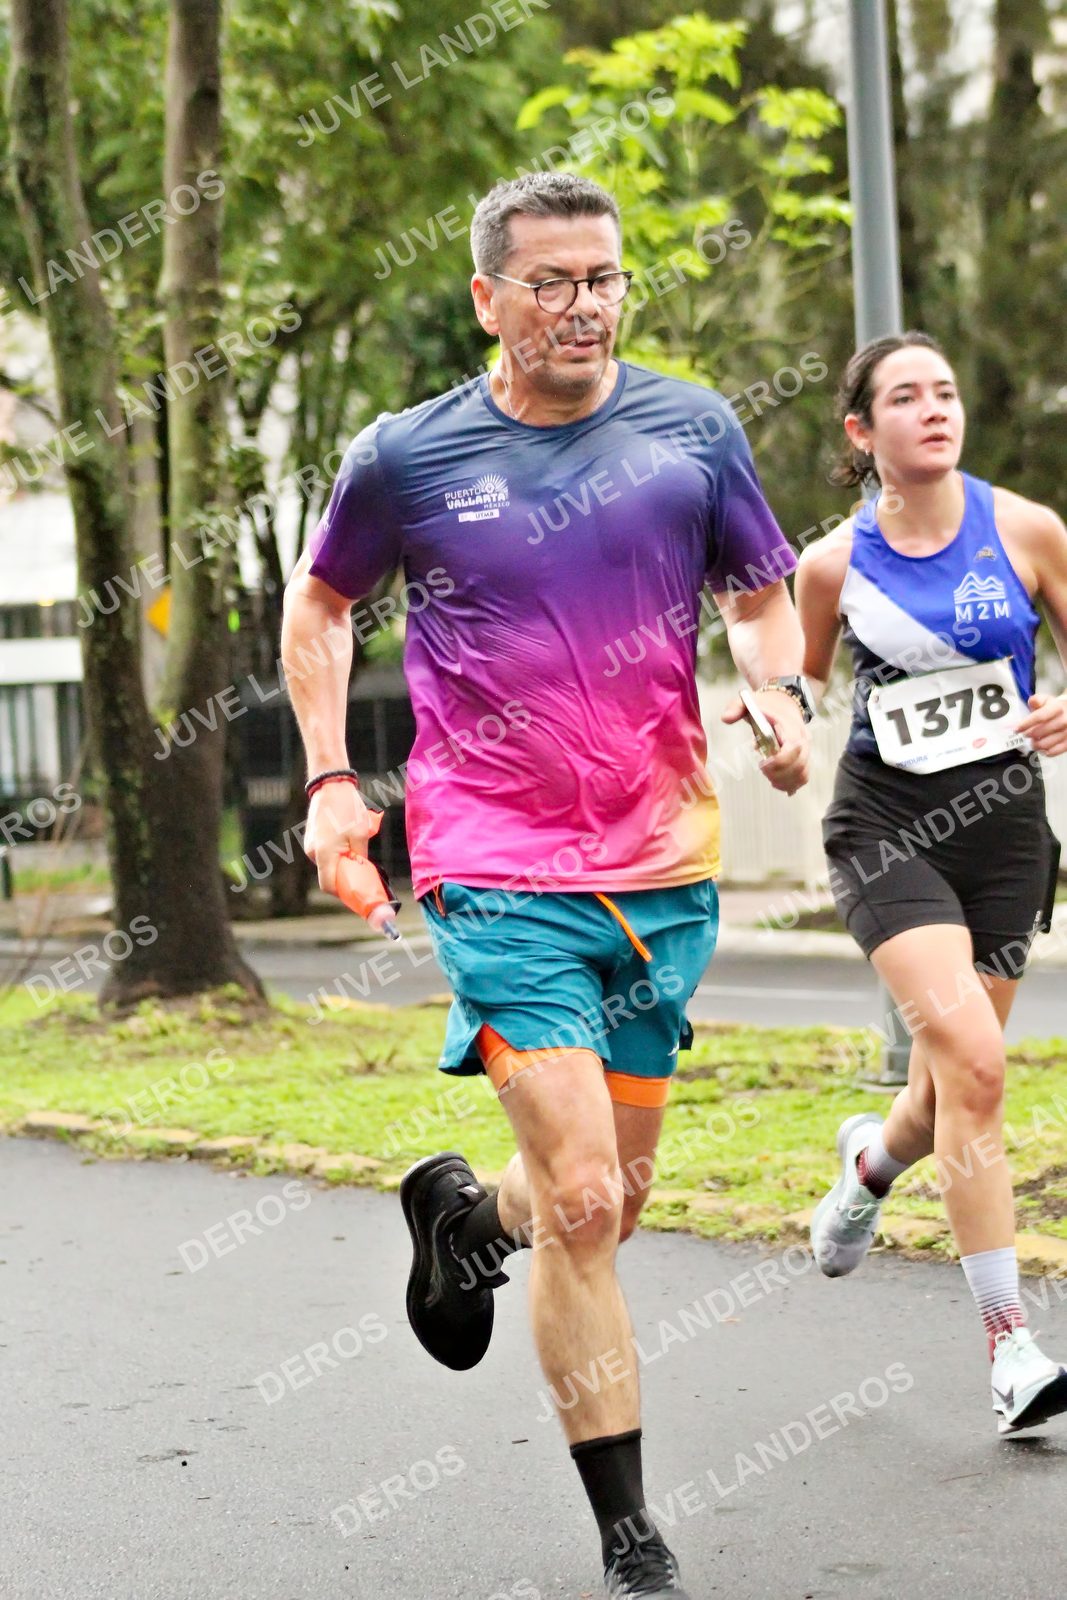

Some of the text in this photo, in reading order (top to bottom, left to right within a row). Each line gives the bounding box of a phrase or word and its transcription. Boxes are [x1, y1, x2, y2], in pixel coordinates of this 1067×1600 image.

[444, 488, 480, 500] PUERTO
[446, 493, 506, 510] VALLARTA
[886, 683, 1010, 746] 1378
